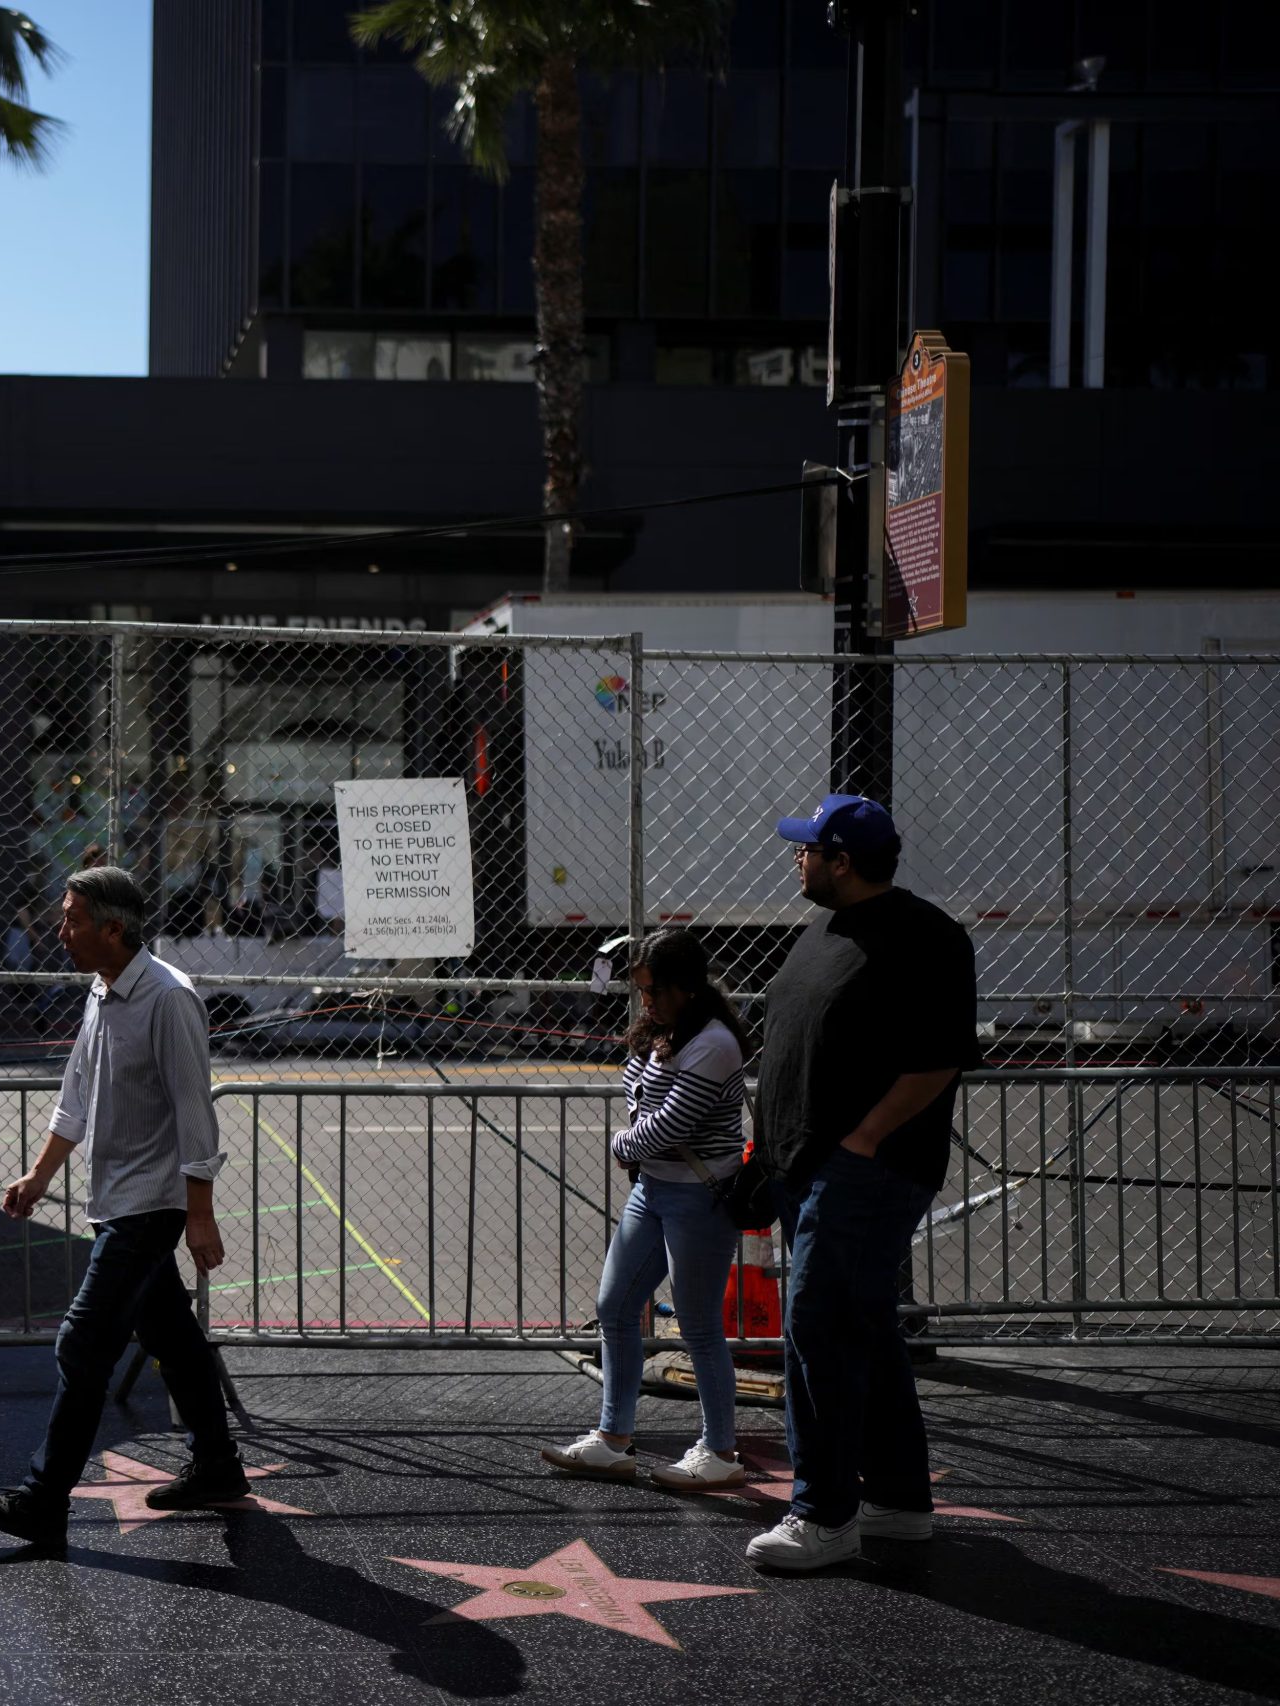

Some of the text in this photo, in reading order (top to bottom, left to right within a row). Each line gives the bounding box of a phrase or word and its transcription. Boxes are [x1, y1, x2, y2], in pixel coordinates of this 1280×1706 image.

[914, 353, 919, 367] 3
[348, 804, 457, 818] THIS PROPERTY
[375, 821, 431, 833] CLOSED
[354, 836, 456, 850] TO THE PUBLIC
[371, 853, 441, 867] NO ENTRY
[375, 870, 439, 883] WITHOUT
[366, 886, 451, 899] PERMISSION
[368, 915, 451, 925] LAMC Secs. 41.24(a),
[412, 925, 457, 936] 41.56(b)(2)
[556, 1558, 633, 1624] LEW WASSERMAN
